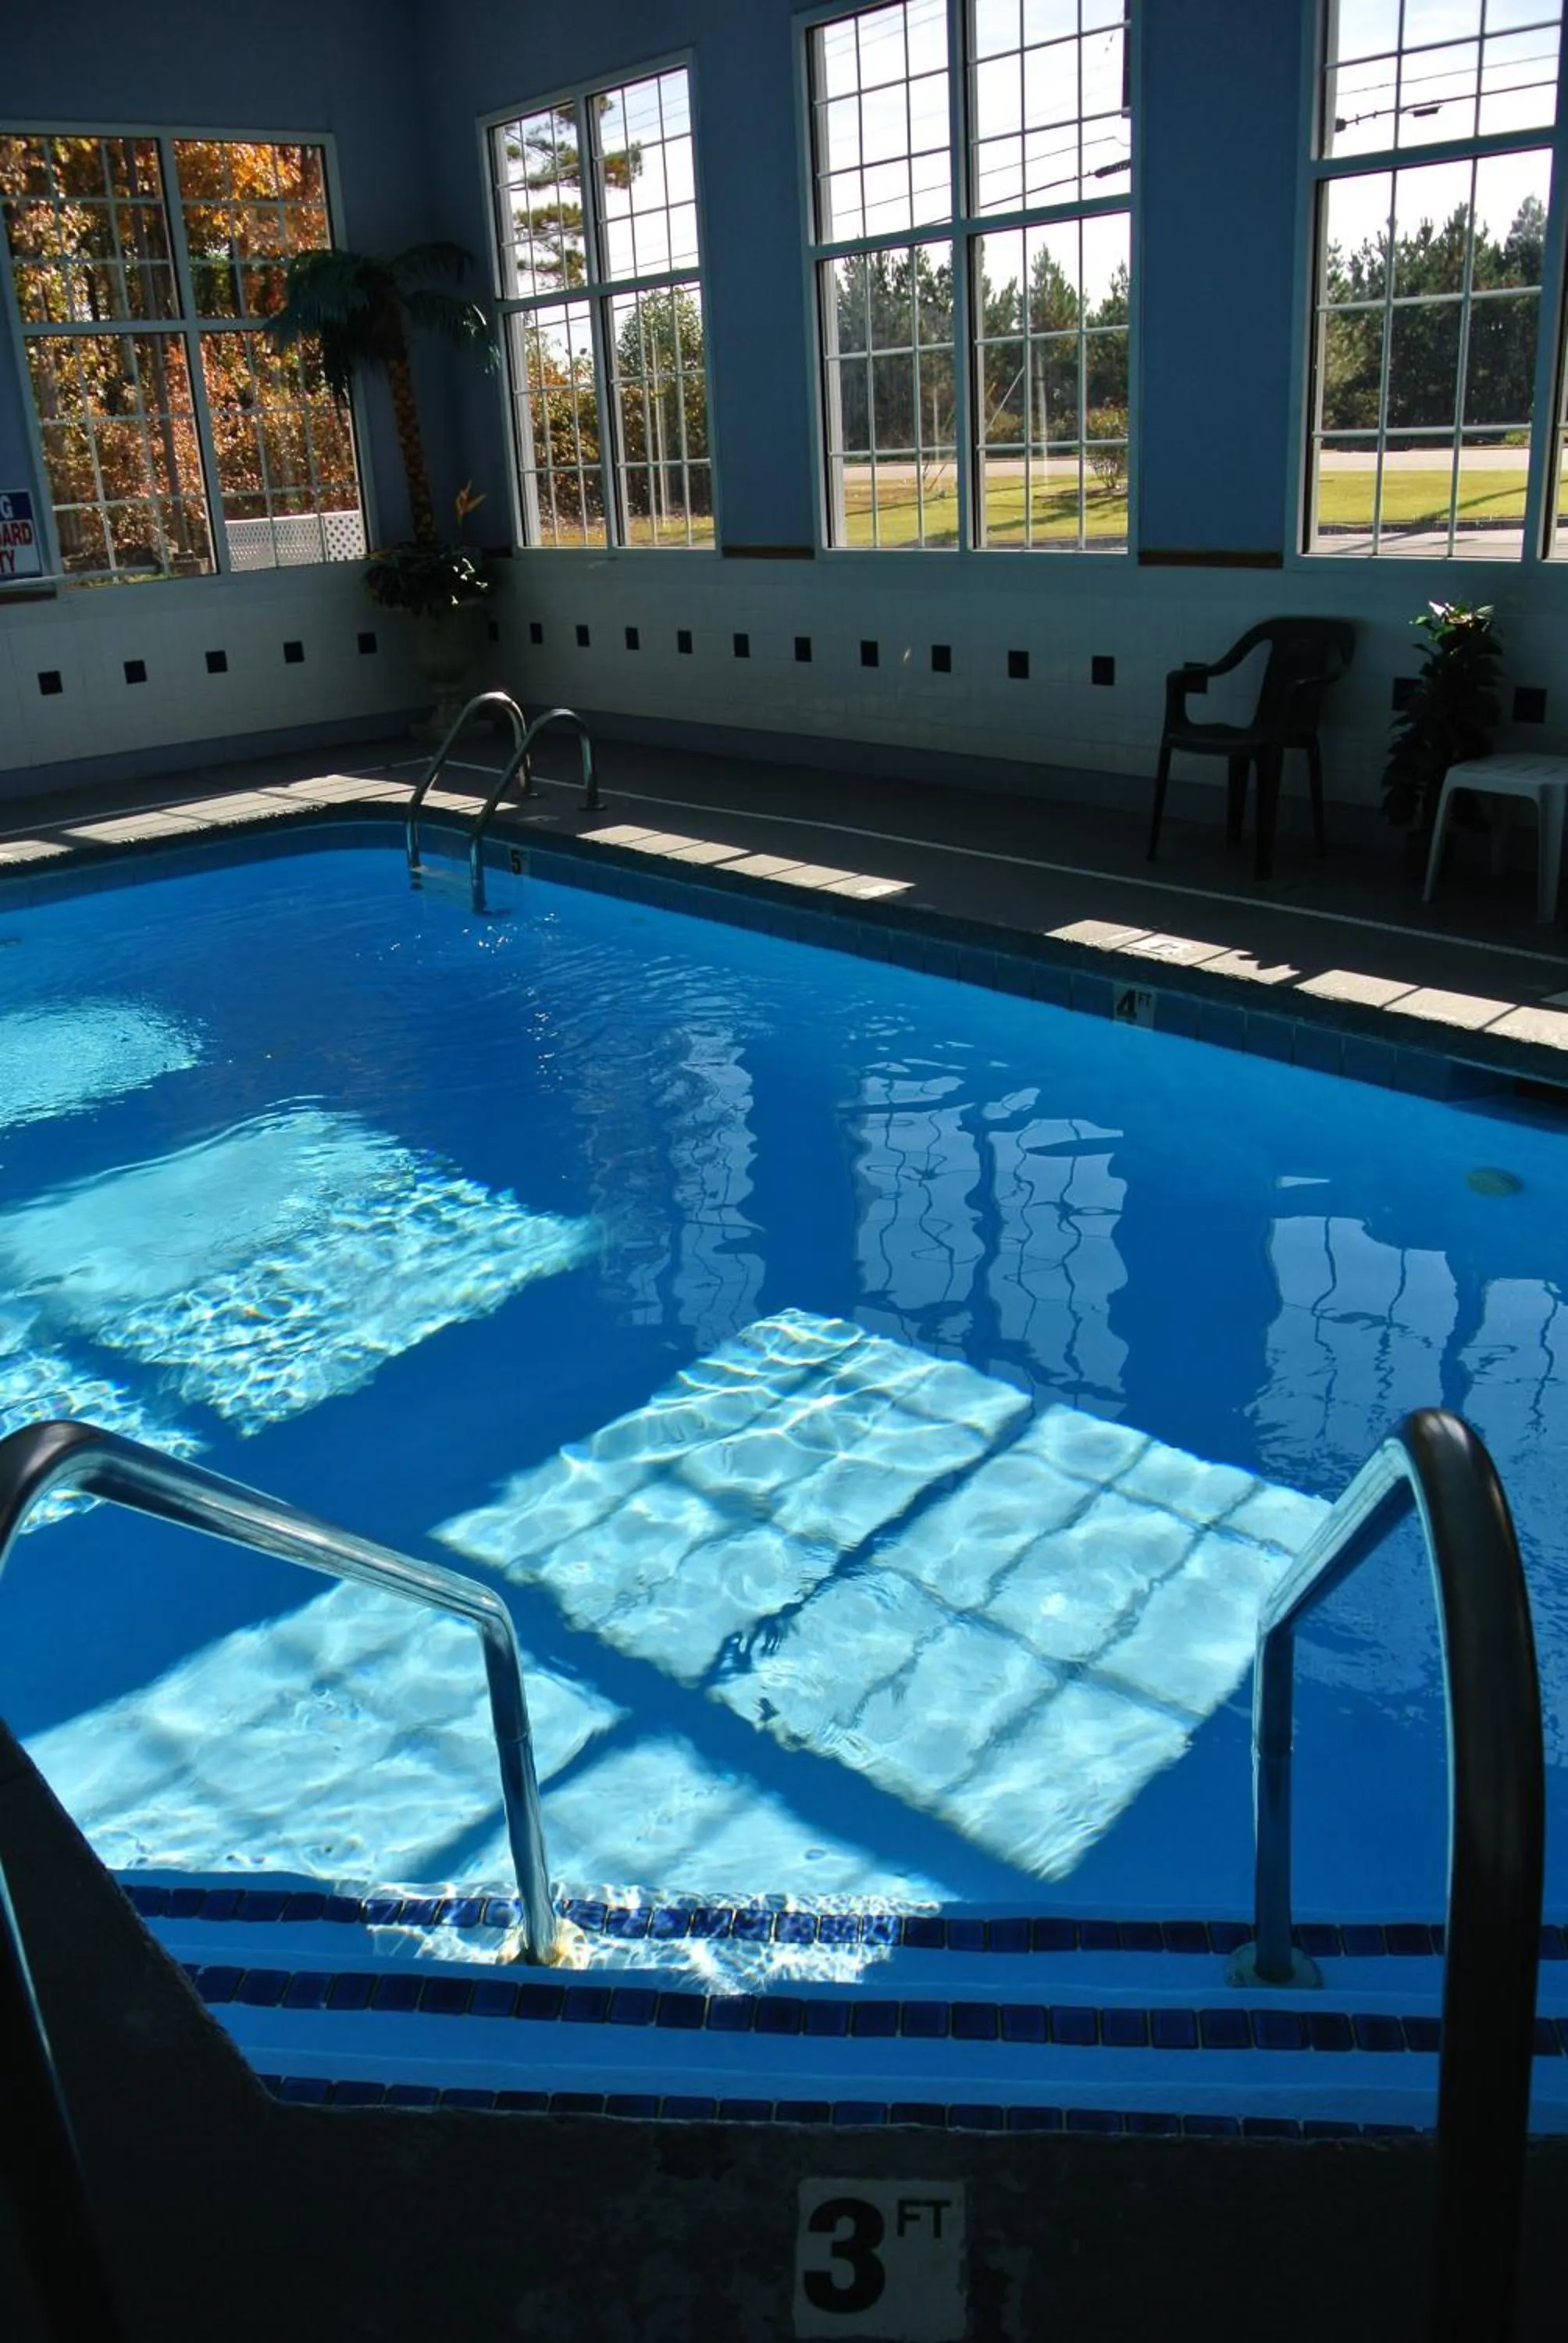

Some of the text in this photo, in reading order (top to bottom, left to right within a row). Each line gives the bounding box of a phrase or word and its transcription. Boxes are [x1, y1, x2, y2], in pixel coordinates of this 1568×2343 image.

[0, 522, 32, 545] ARD
[511, 849, 521, 875] 5
[1117, 989, 1137, 1018] 4
[804, 2197, 952, 2315] 3 FT
